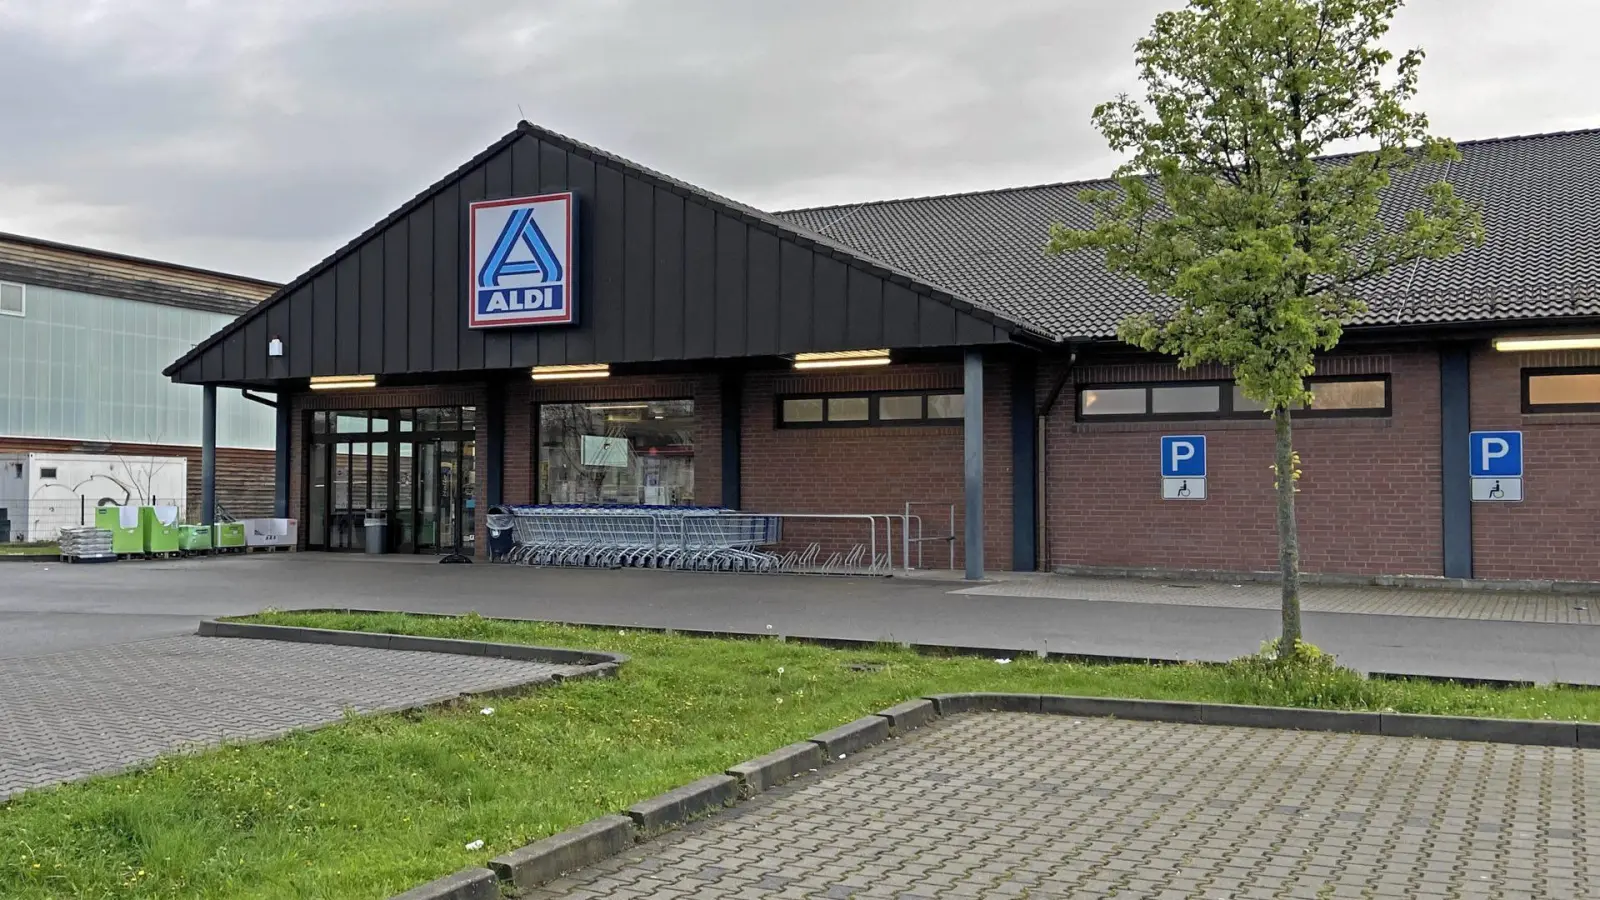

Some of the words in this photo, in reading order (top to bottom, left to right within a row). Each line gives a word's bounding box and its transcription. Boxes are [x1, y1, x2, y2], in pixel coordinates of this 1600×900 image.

[485, 288, 553, 312] ALDI
[1171, 440, 1195, 472] P
[1481, 437, 1510, 471] P
